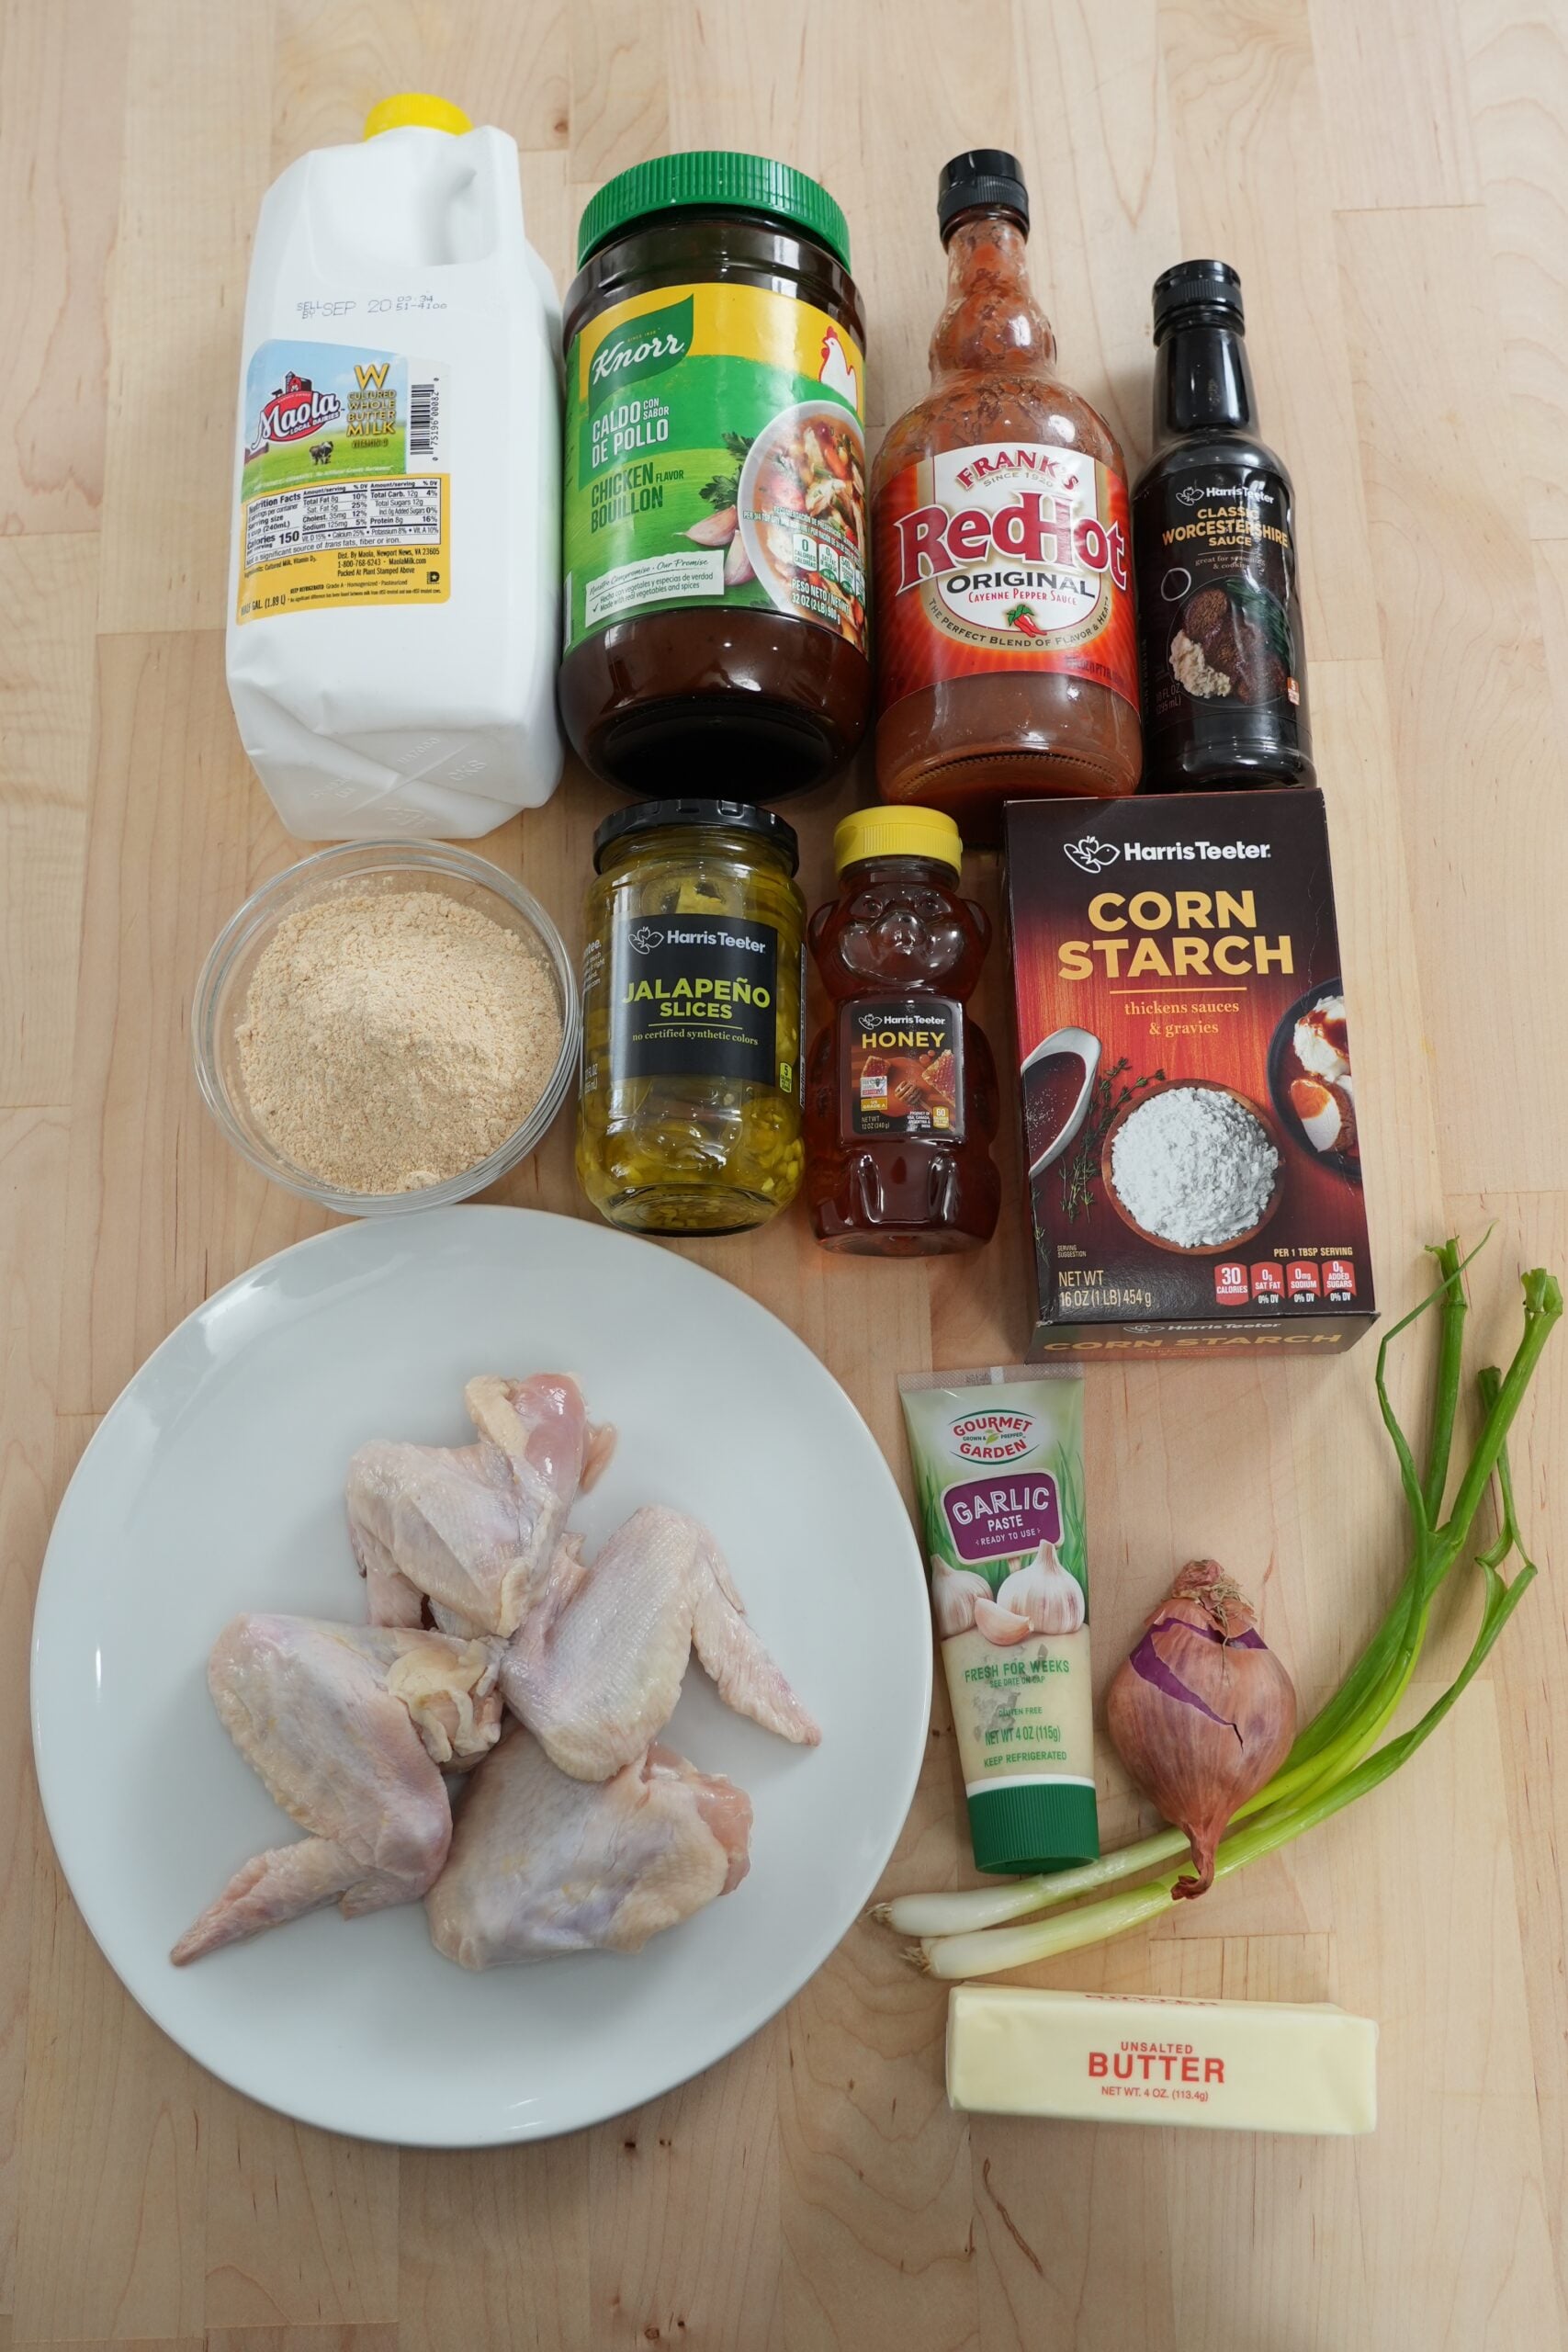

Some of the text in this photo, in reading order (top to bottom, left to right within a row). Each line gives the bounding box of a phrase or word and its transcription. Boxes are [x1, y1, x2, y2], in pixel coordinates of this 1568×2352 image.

[296, 300, 322, 311] SELL
[321, 300, 392, 316] SEP 20
[301, 310, 316, 320] BY
[592, 334, 685, 385] Knorr
[354, 363, 390, 390] W
[347, 390, 397, 401] CULTURED
[347, 401, 396, 412] WHOLE
[251, 392, 341, 450] Maola
[289, 412, 340, 435] LOCAL DAIRIES
[346, 410, 396, 423] BUTTER
[345, 421, 396, 437] MILK
[592, 398, 669, 470] CALDO CON SABOR DE POLLO
[983, 472, 1054, 487] SINCE 1920
[279, 492, 301, 503] Facts
[591, 461, 684, 535] CHICKEN FLAVOR BOUILLON
[1197, 506, 1260, 519] CLASSIC
[279, 531, 299, 544] 150
[897, 491, 1127, 593] RedHot
[1162, 520, 1290, 549] WORCESTERSHIRE
[1209, 536, 1252, 548] SAUCE
[338, 559, 381, 568] 1-800-768-6243
[675, 559, 708, 568] Promise
[1195, 555, 1216, 567] great
[600, 592, 614, 603] Hecha
[615, 588, 625, 596] con
[625, 582, 650, 596] vegetales
[656, 577, 682, 586] especias
[691, 572, 713, 581] verdad
[946, 571, 1095, 598] ORIGINAL
[600, 582, 700, 612] Made with real vegetables and spices
[801, 595, 810, 607] OZ
[968, 590, 1009, 603] CAYENNE
[1012, 588, 1047, 601] PEPPER
[928, 597, 942, 619] THE
[941, 617, 987, 642] PERFECT
[990, 636, 1031, 647] BLEND
[1055, 627, 1093, 645] FLAVOR
[1093, 623, 1100, 632] &
[1088, 889, 1257, 932] CORN
[1057, 935, 1294, 981] STARCH
[622, 977, 771, 1009] JALAPEÑO
[660, 1001, 733, 1020] SLICES
[1124, 1001, 1240, 1015] thickens sauces
[1148, 1020, 1219, 1037] & gravies
[632, 1028, 759, 1046] no certified synthetic colors
[862, 1031, 945, 1049] HONEY
[1273, 1247, 1353, 1257] PER 1 TBSP SERVING
[1332, 1261, 1343, 1272] 0g
[1058, 1270, 1104, 1287] NET WT
[1222, 1267, 1242, 1285] 30
[1261, 1270, 1273, 1281] 0g
[1295, 1268, 1312, 1281] 0mg
[1328, 1272, 1349, 1281] ADDED
[1216, 1284, 1247, 1294] CALORIES
[1255, 1281, 1280, 1290] SAT FAT
[1291, 1281, 1317, 1289] SODIUM
[1326, 1280, 1352, 1288] SUGARS
[1060, 1288, 1152, 1308] 16 OZ (1 LB) 454 g
[1258, 1294, 1279, 1305] 0% DV
[1293, 1294, 1314, 1303] 0% DV
[1330, 1292, 1351, 1303] 0% DV
[1043, 1340, 1163, 1351] CORN
[1174, 1334, 1342, 1347] STARCH
[953, 1417, 1032, 1437] GOURMET
[1000, 1431, 1023, 1440] PREPPED
[959, 1439, 1027, 1459] GARDEN
[952, 1487, 1050, 1526] GARLIC
[987, 1514, 1023, 1532] PASTE
[980, 1534, 1006, 1545] READY
[1020, 1528, 1036, 1538] USE
[964, 1659, 1069, 1683] FRESH FOR WEEKS
[990, 1676, 1045, 1689] SEE DATE ON CAP
[998, 1708, 1023, 1717] GLUTEN
[985, 1725, 1062, 1746] NET WT 4 OZ (115g)
[984, 1751, 1067, 1768] KEEP REFRIGERATED
[1121, 2041, 1194, 2054] UNSALTED
[1089, 2052, 1225, 2084] BUTTER
[1101, 2086, 1209, 2102] NET WT. 4 OZ. (113.4g)
